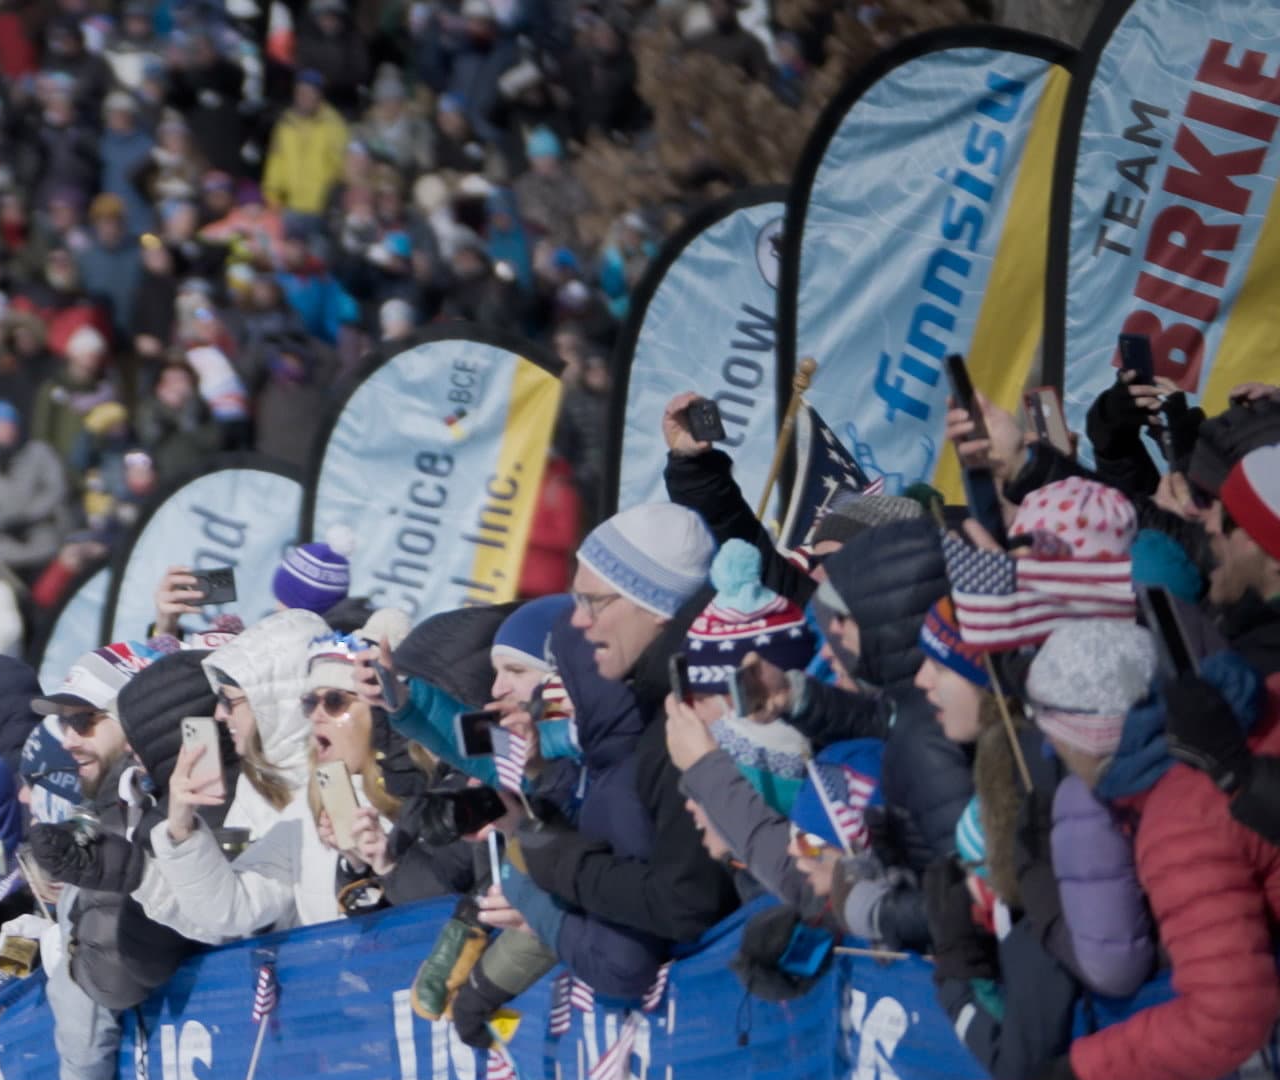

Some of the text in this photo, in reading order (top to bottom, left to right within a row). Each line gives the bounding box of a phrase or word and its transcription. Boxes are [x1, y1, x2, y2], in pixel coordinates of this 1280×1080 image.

[873, 71, 1028, 423] finnsisu
[1092, 99, 1169, 256] TEAM
[1112, 38, 1280, 394] BIRKIE
[461, 463, 523, 549] Inc.
